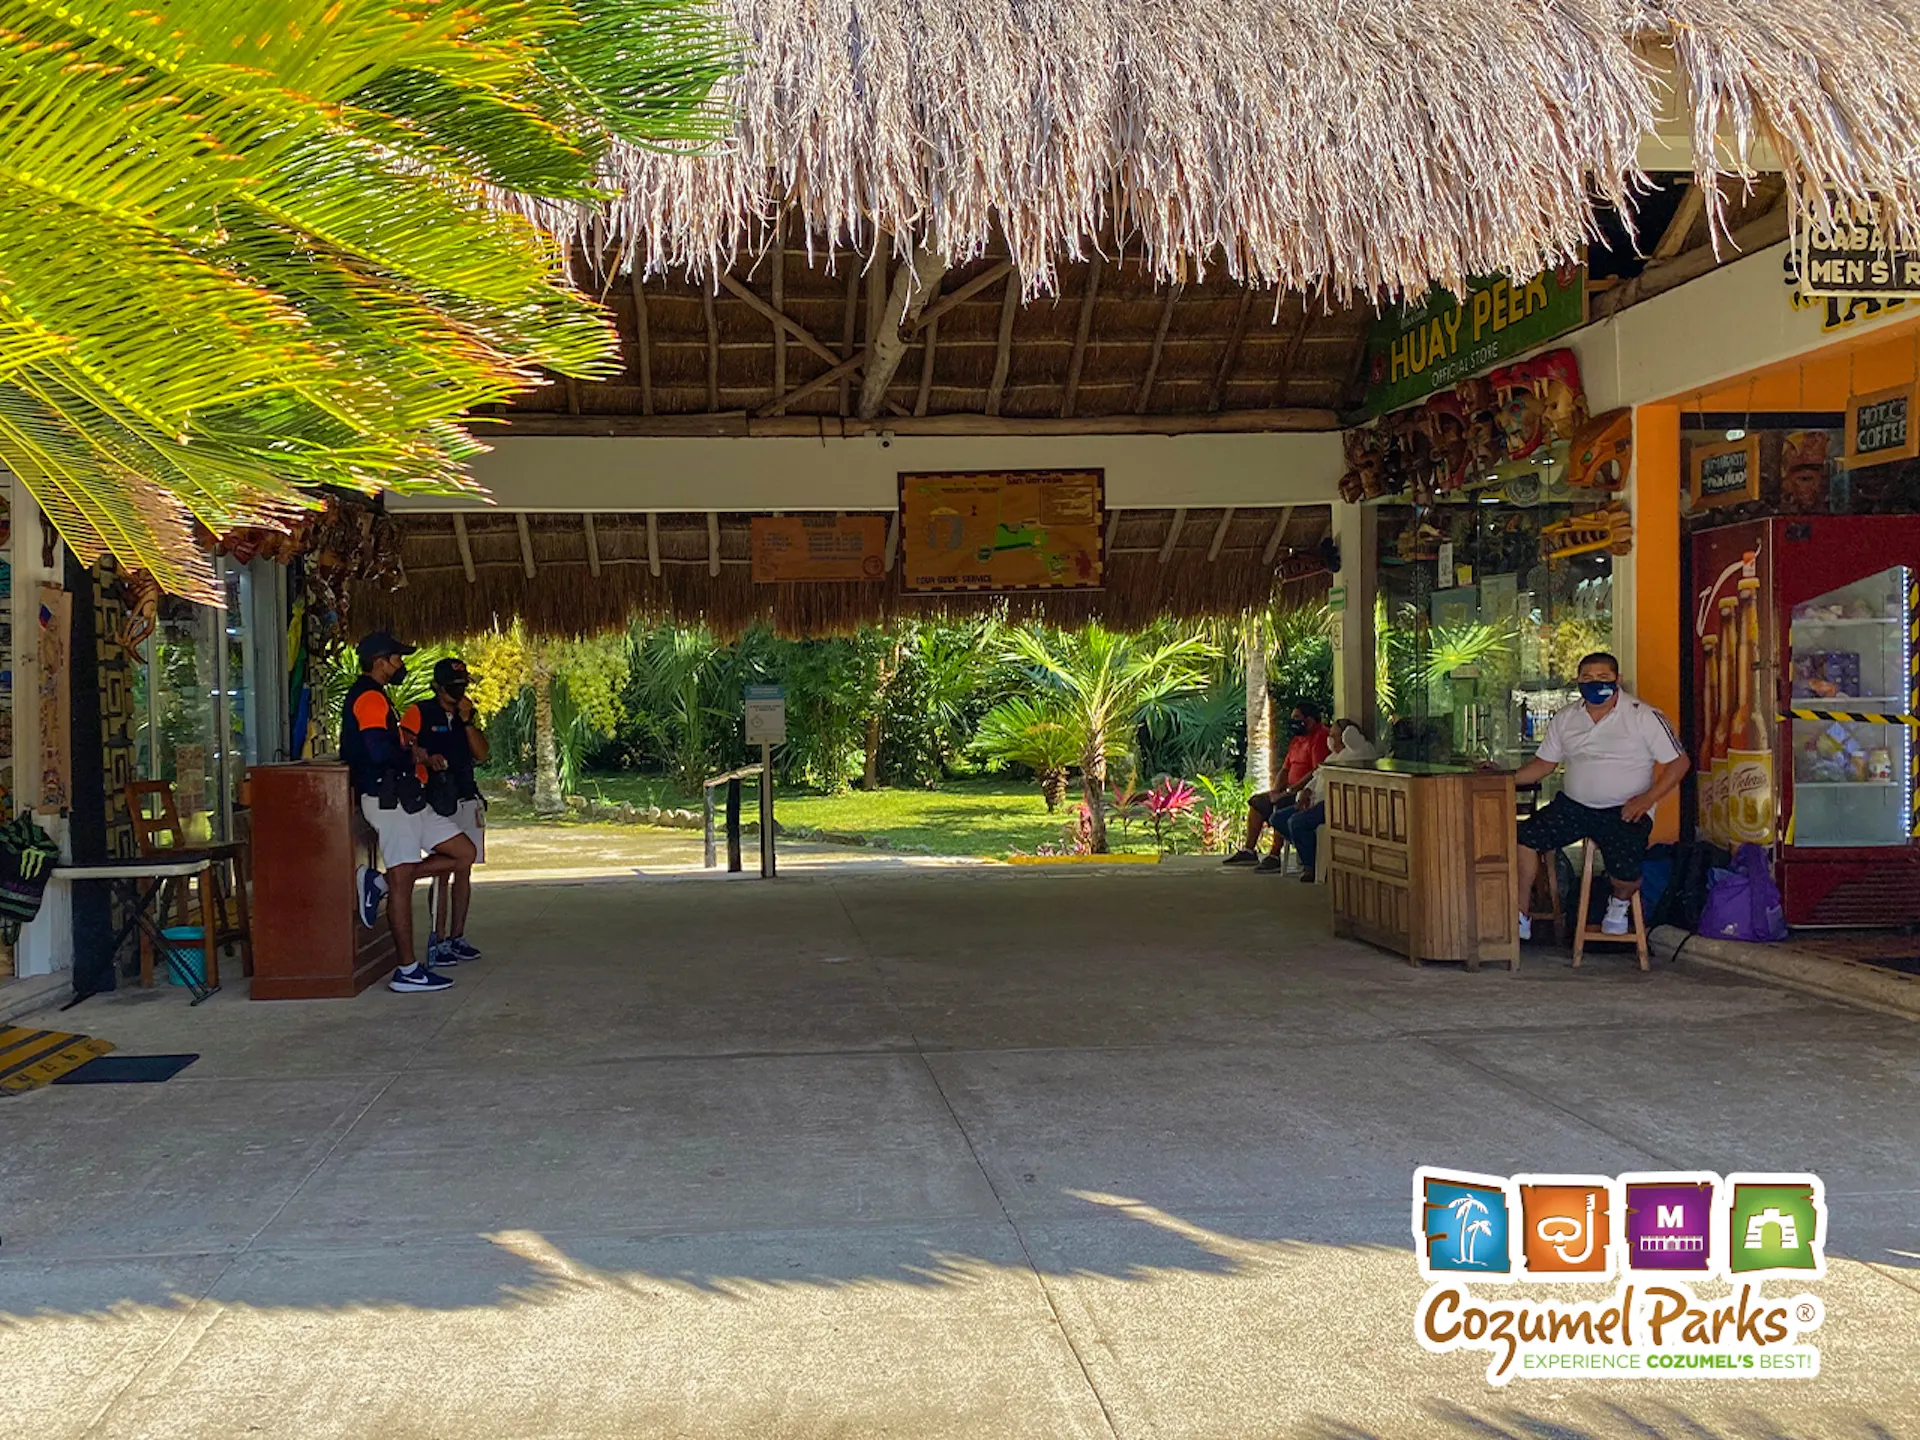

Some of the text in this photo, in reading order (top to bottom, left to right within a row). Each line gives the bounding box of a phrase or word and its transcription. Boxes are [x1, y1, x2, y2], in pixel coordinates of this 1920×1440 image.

[1811, 227, 1920, 251] CABALL
[1811, 259, 1889, 284] MEN'S
[1390, 272, 1548, 383] HUAY PEEK
[1470, 341, 1498, 369] STORE
[1859, 406, 1886, 426] HOT
[1857, 420, 1907, 451] COFFEE
